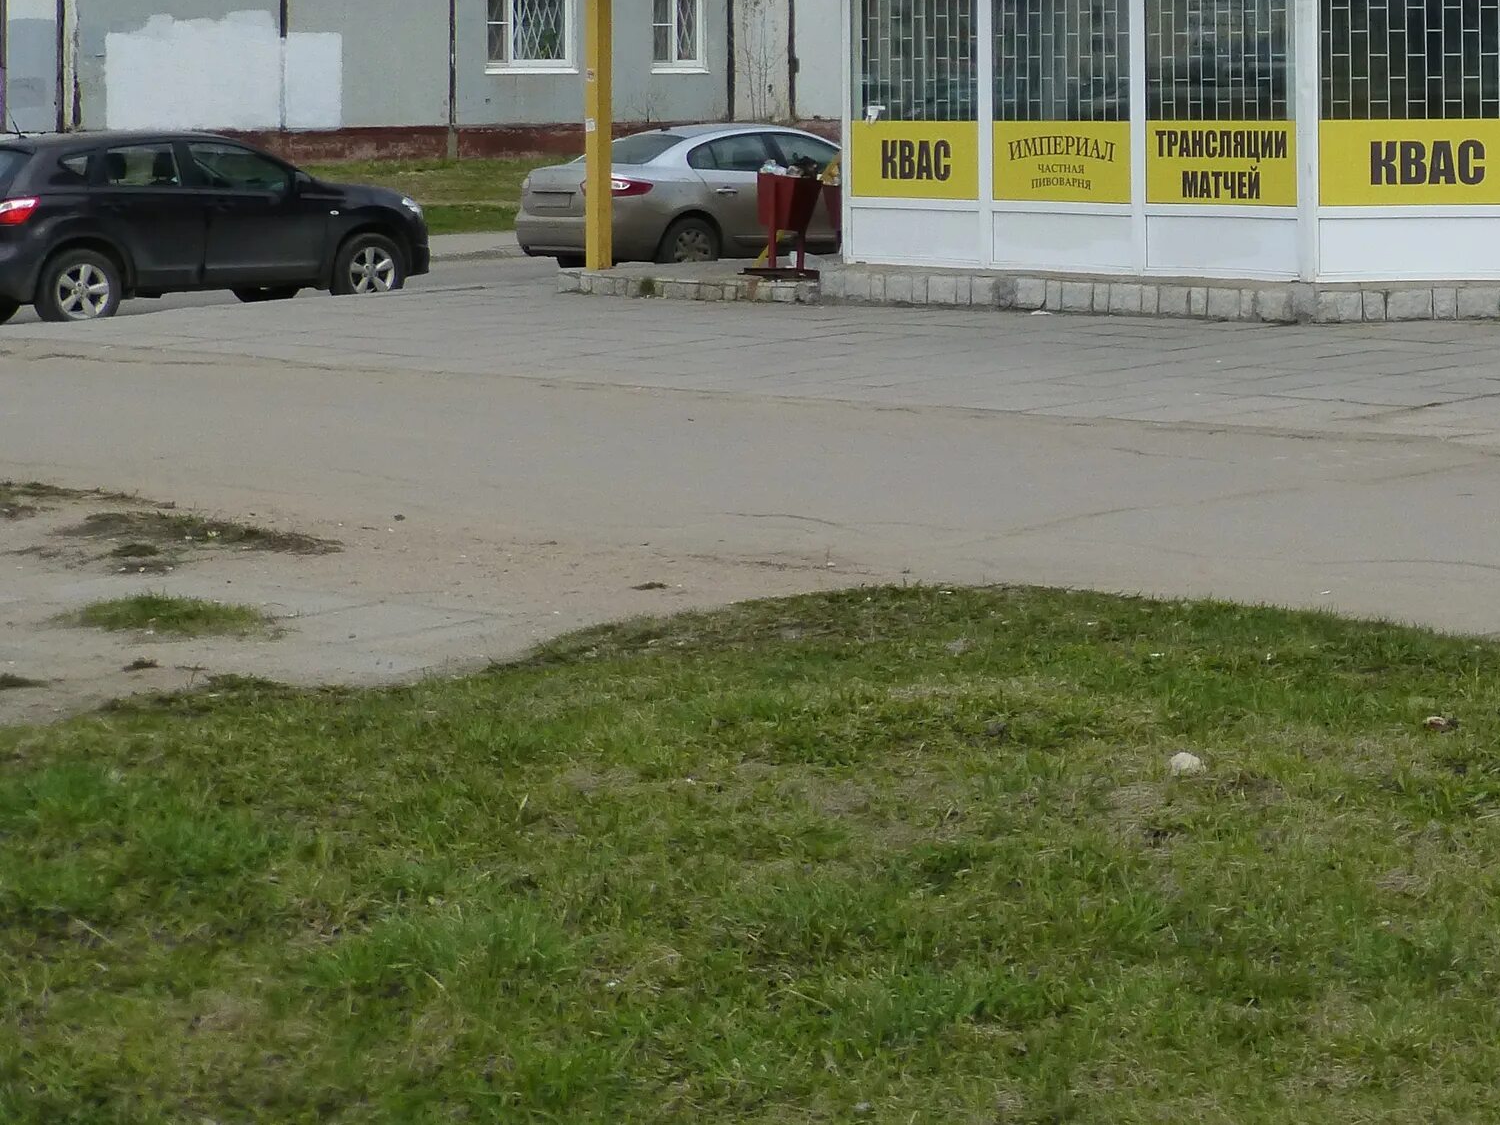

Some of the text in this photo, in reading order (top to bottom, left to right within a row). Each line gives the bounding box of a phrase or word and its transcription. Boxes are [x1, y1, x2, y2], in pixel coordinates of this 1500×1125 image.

[881, 139, 951, 182] КВАС
[1008, 135, 1116, 162] ИМПЕРИАЛ
[1155, 130, 1287, 164] ТРАНСЛЯЦИИ
[1370, 139, 1486, 186] КВАС
[1031, 176, 1091, 190] ПИВОВАРНЯ
[1037, 163, 1085, 174] ЧАСТНАЯ
[1182, 166, 1260, 200] МАТЧЕЙ
